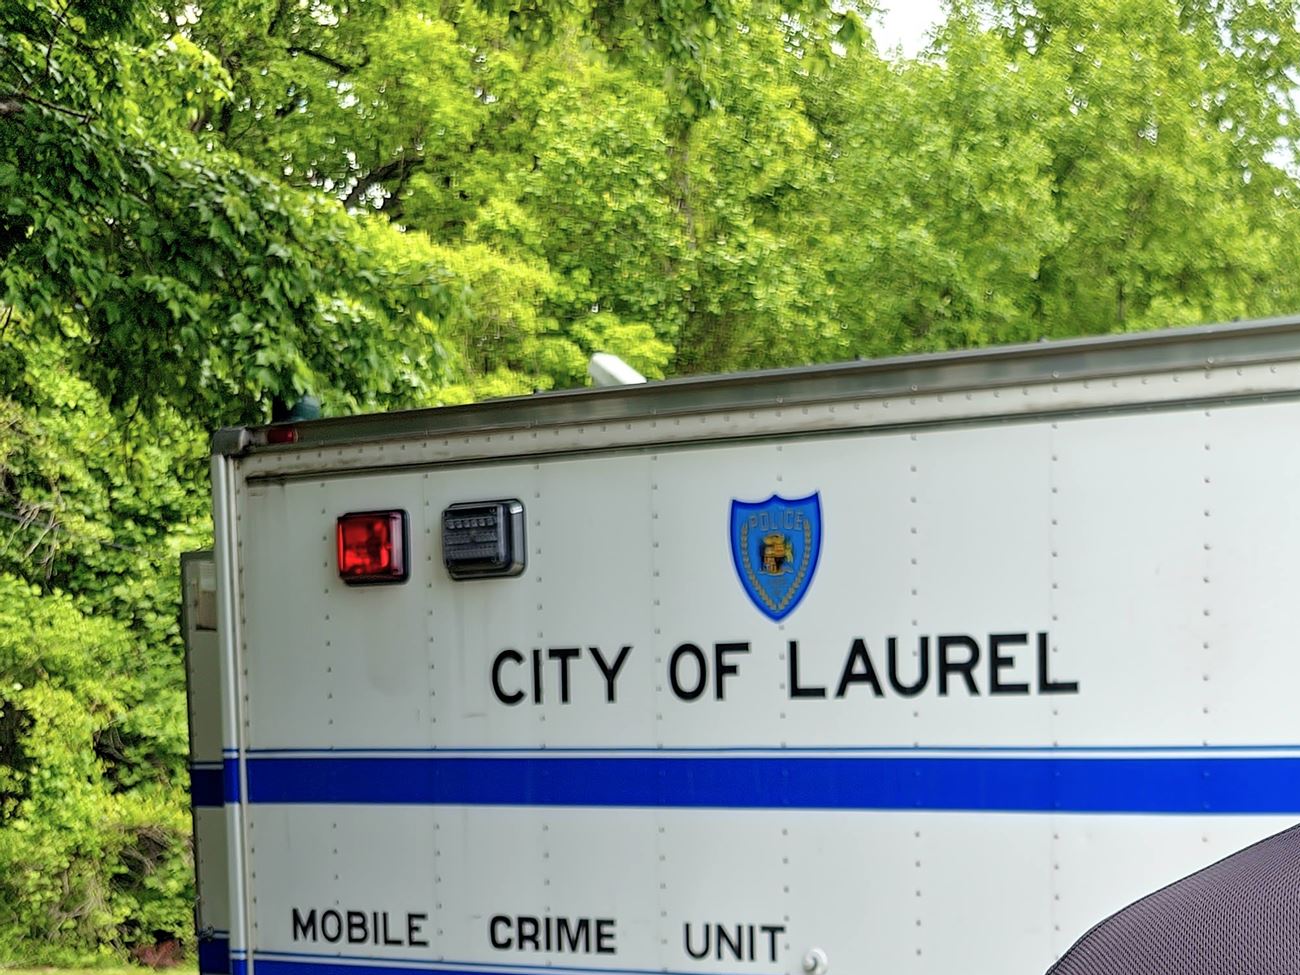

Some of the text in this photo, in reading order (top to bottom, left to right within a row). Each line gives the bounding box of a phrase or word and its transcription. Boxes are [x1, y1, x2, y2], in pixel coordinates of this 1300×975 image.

[748, 509, 804, 531] POLICE
[490, 632, 1080, 705] CITY OF LAUREL
[291, 907, 786, 962] MOBILE CRIME UNIT
